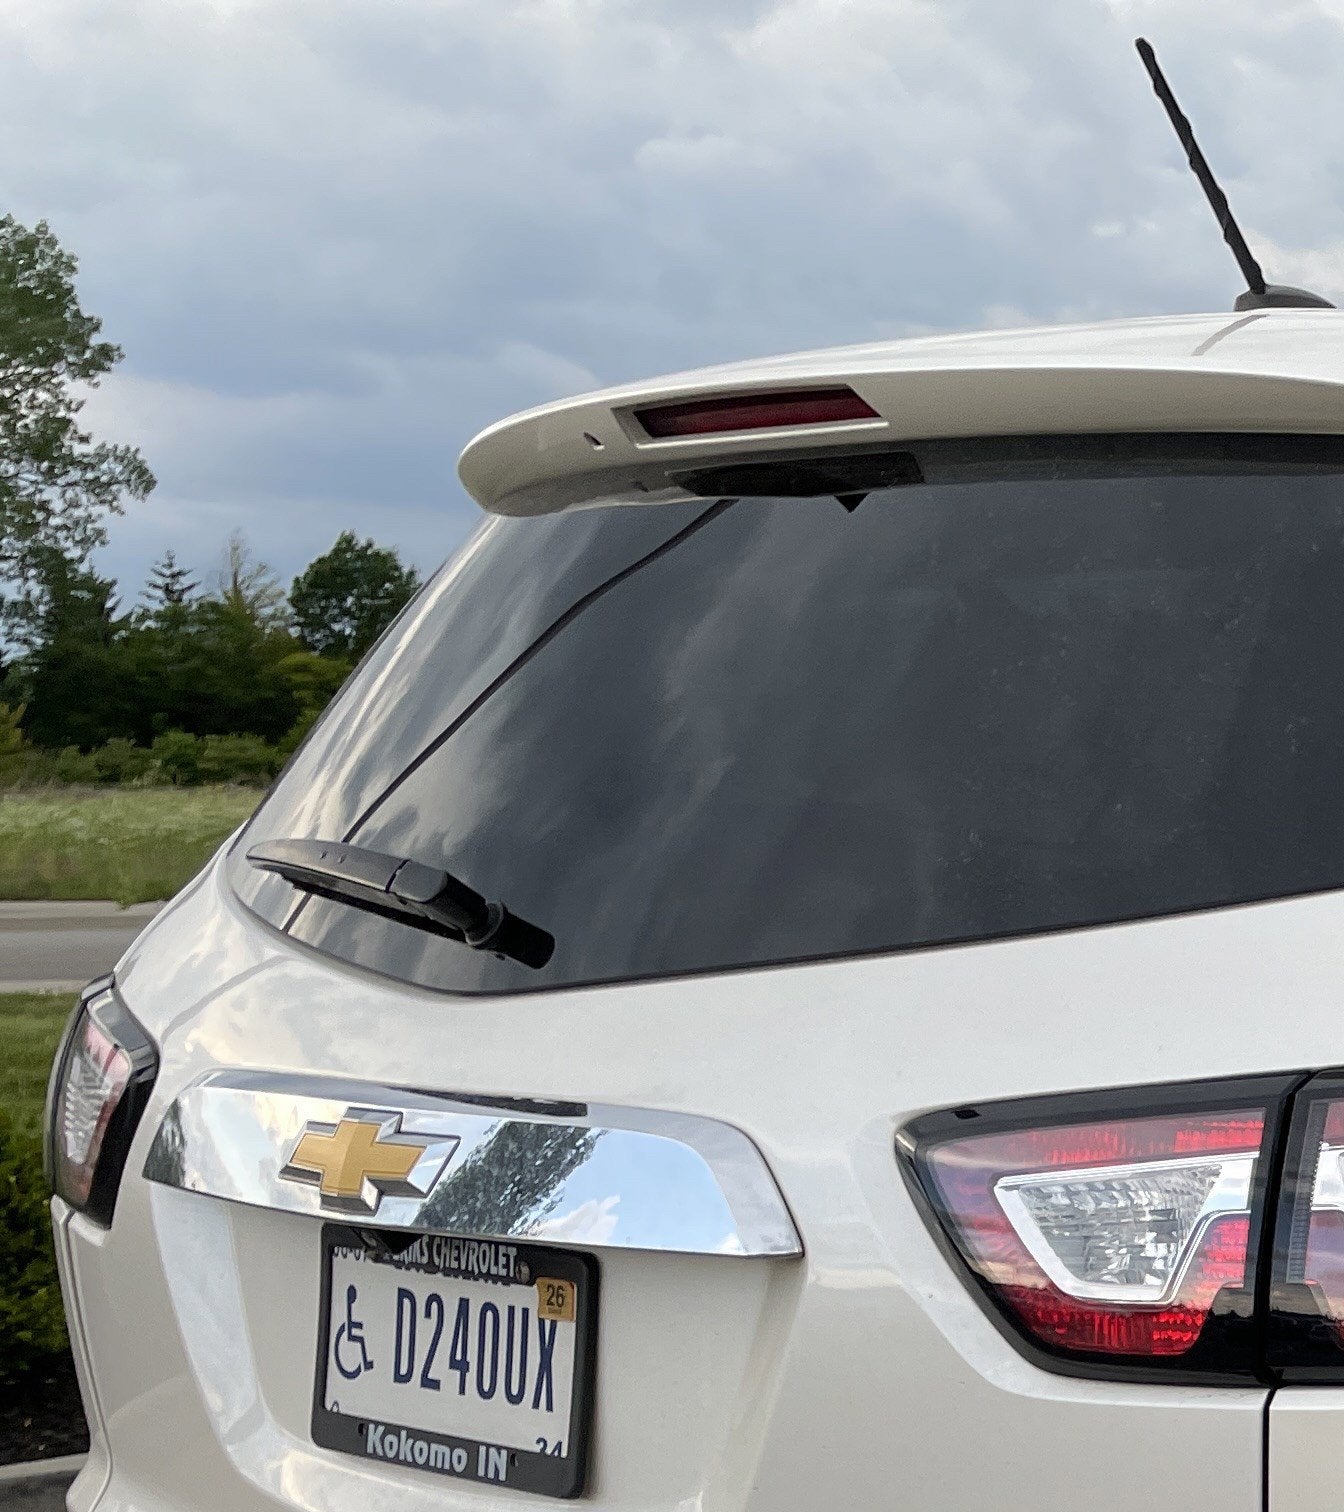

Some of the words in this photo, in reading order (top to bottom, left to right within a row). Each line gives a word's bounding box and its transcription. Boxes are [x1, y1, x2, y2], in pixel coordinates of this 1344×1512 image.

[432, 1237, 518, 1277] CHEVROLET
[545, 1283, 566, 1308] 26
[392, 1286, 558, 1413] D240UX
[366, 1423, 468, 1474] Kokomo
[477, 1444, 508, 1482] IN
